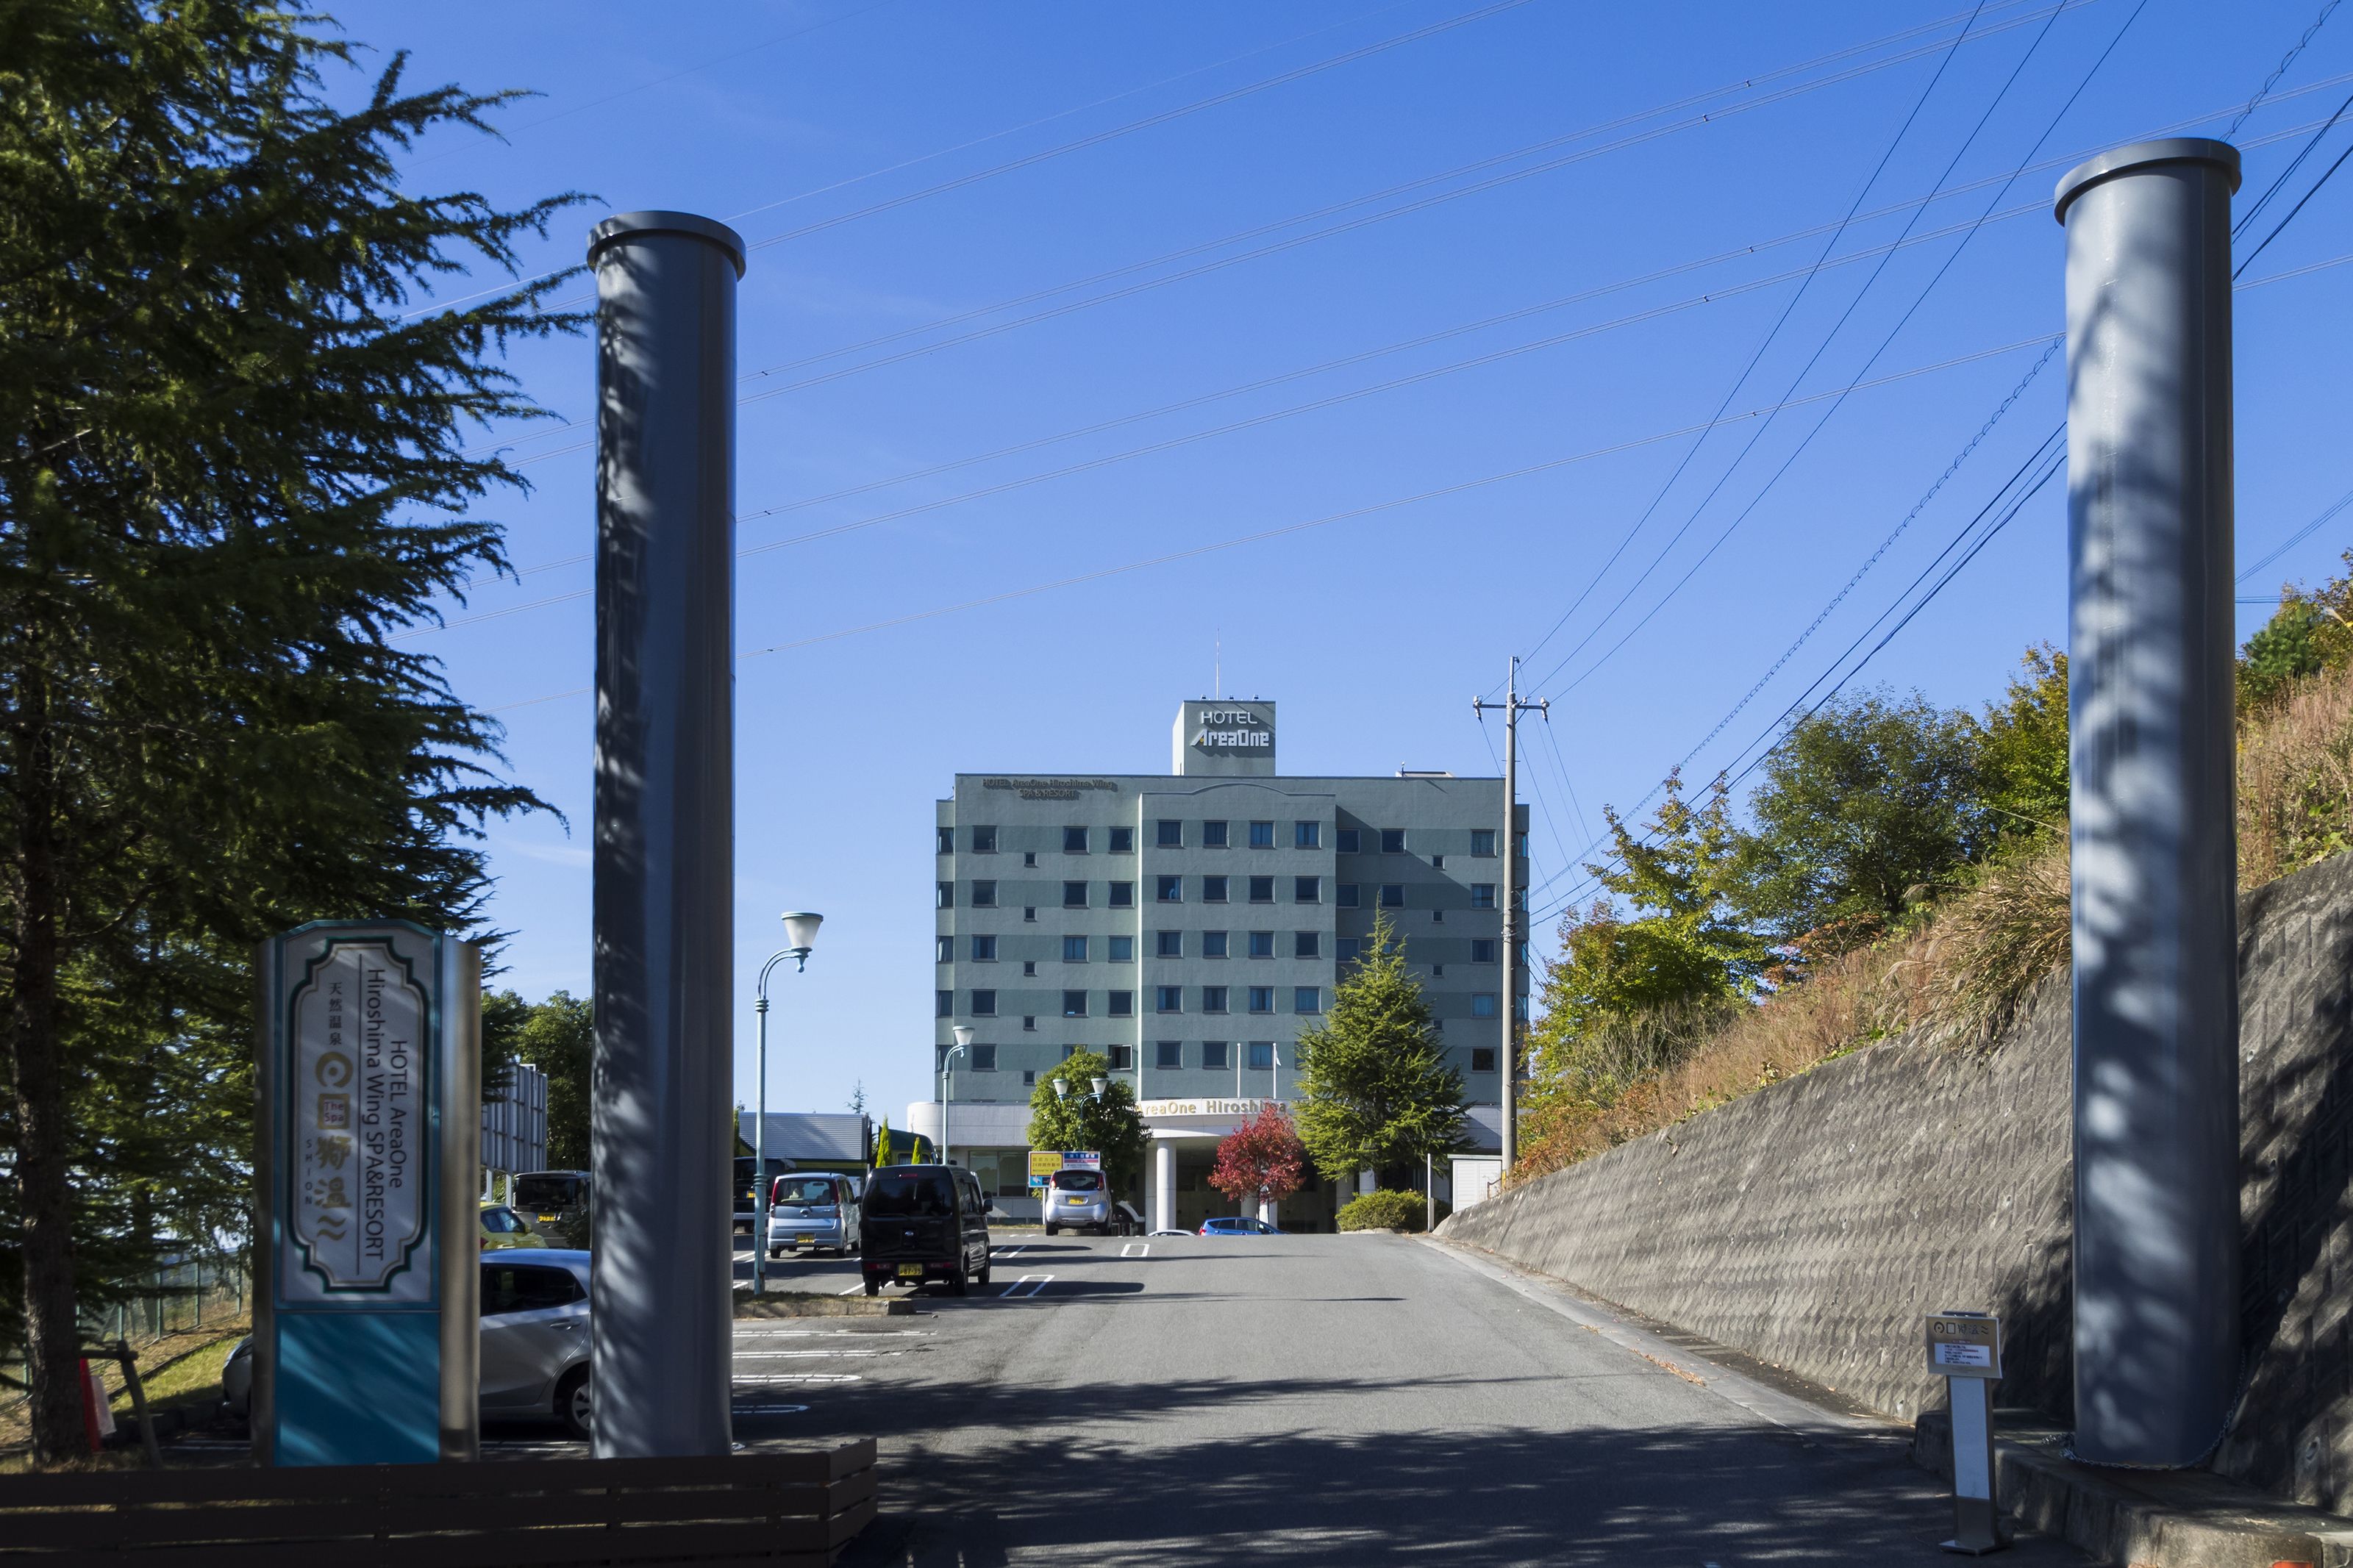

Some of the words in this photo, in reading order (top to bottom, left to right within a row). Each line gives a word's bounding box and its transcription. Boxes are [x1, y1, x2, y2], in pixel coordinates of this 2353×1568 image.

[1201, 711, 1257, 724] HOTEL
[1190, 728, 1269, 747] AreaOne
[982, 778, 1008, 787] HOTEL
[1092, 779, 1112, 788] Wing
[1019, 789, 1033, 797] SPA
[329, 982, 342, 1045] 天然温泉
[368, 970, 385, 1067] Hiroshima
[390, 1041, 407, 1101] HOTEL
[324, 1102, 343, 1111] The
[363, 1074, 385, 1125] Wing
[324, 1113, 344, 1122] Spa
[390, 1108, 407, 1188] AreaOne
[365, 1132, 385, 1261] SPA&RESORT
